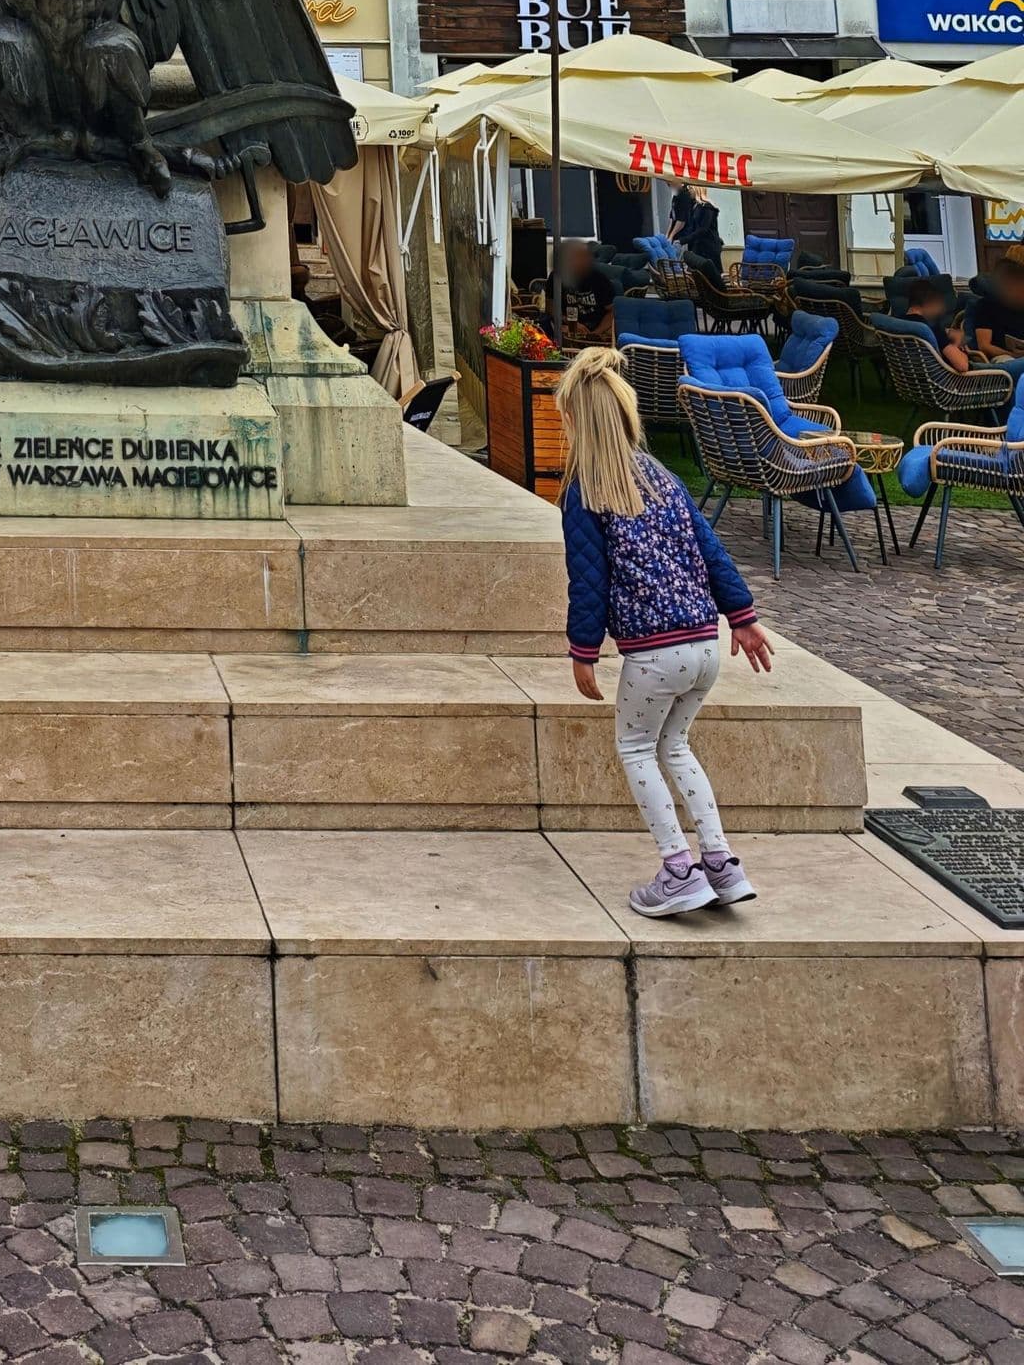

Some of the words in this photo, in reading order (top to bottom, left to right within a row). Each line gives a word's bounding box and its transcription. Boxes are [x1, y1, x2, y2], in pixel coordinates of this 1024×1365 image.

[927, 13, 1024, 37] wakac
[629, 135, 753, 186] ŻYWIEC
[121, 438, 239, 461] DUBIENKA
[6, 464, 127, 488] WARSZAWA
